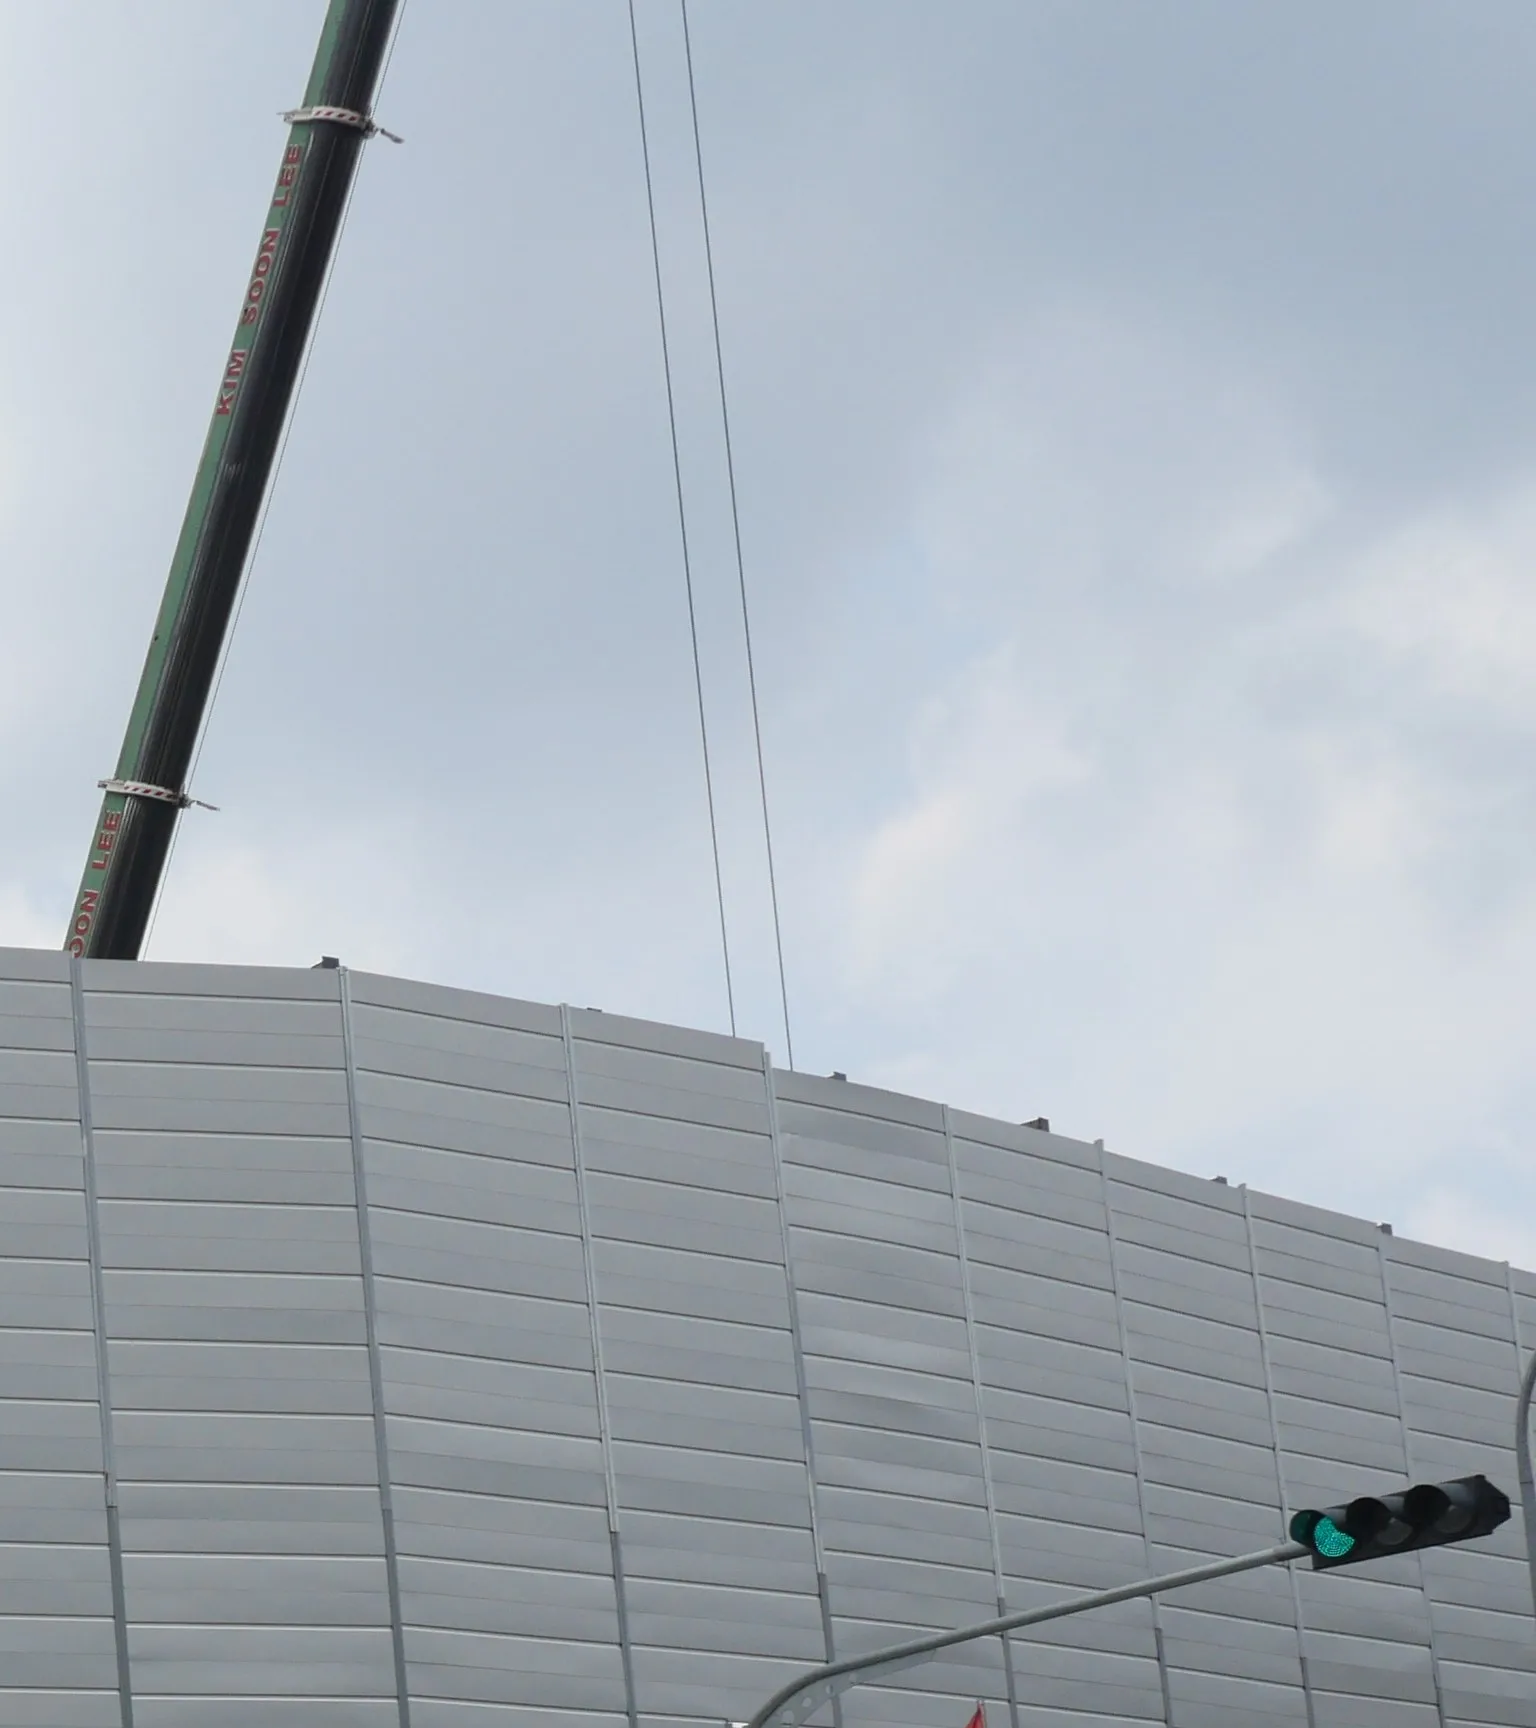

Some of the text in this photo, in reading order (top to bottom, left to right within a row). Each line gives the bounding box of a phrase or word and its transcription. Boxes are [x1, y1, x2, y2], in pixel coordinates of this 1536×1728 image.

[216, 143, 302, 415] KIM SOON LEE
[91, 810, 122, 870] LEE
